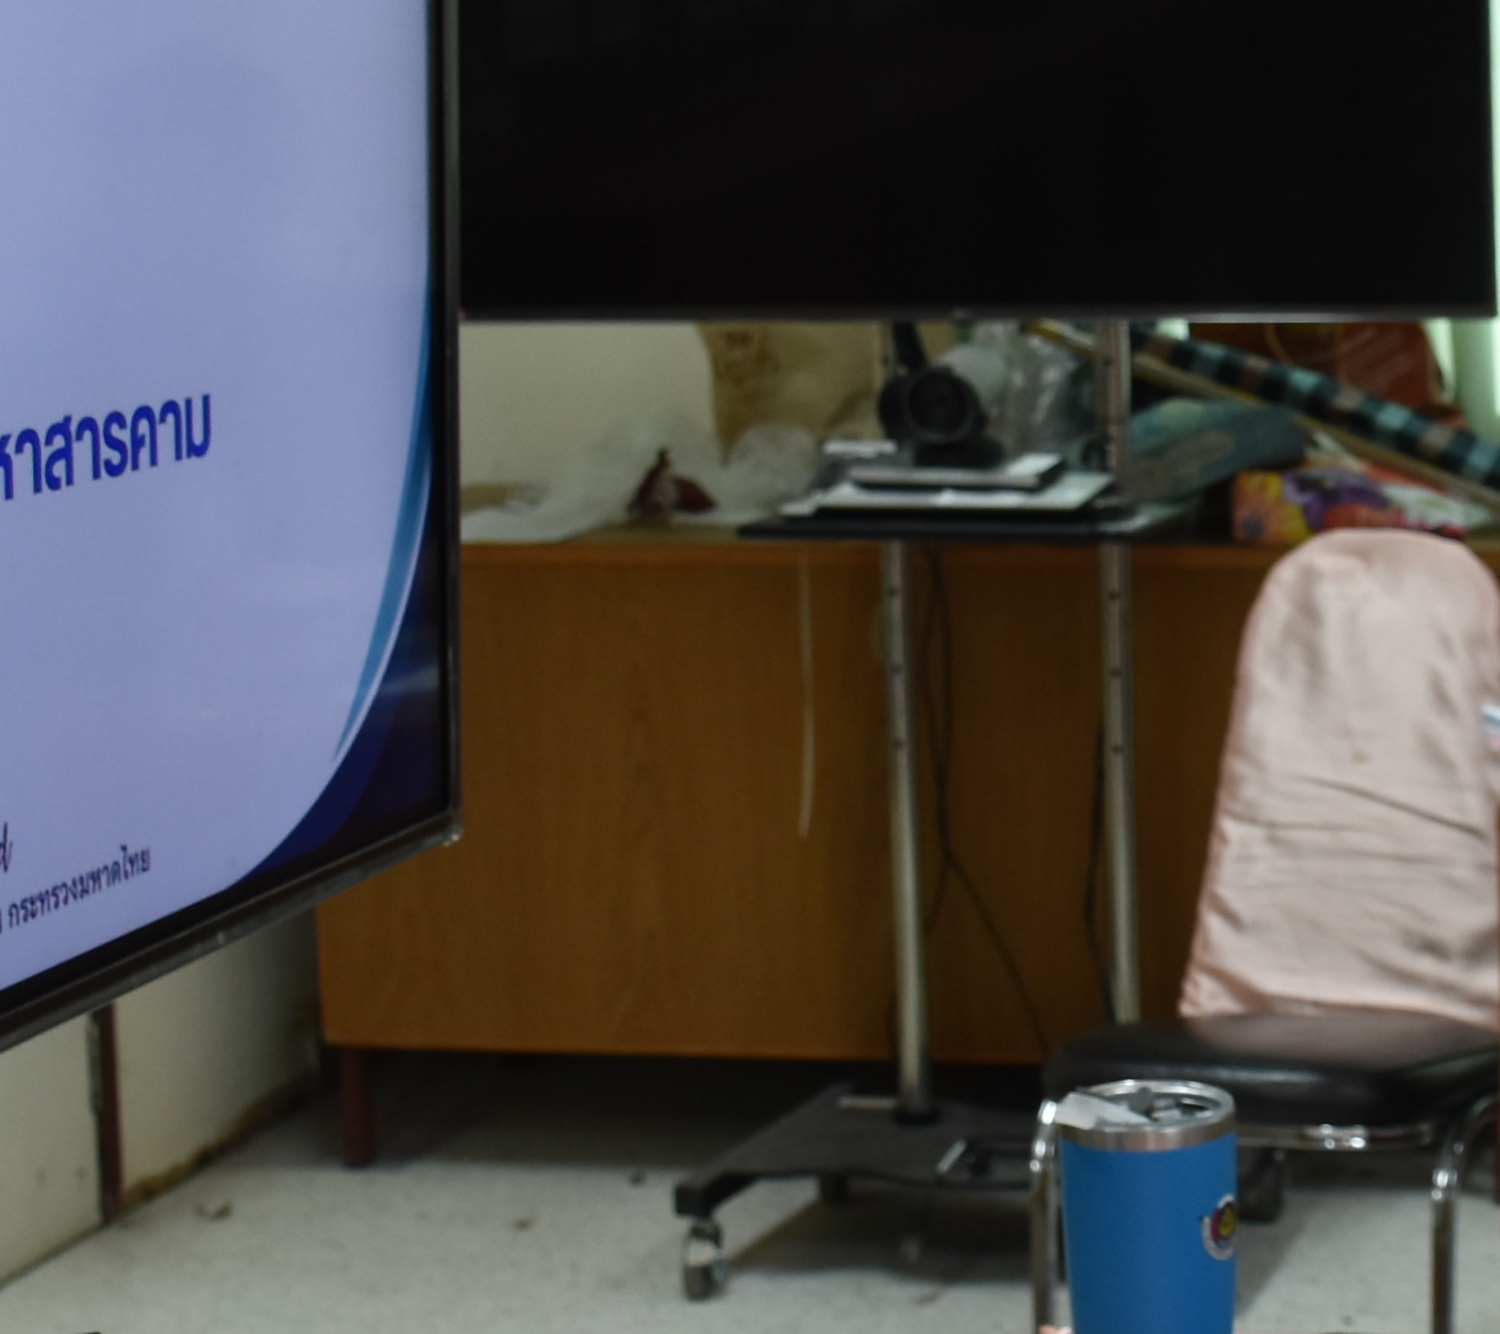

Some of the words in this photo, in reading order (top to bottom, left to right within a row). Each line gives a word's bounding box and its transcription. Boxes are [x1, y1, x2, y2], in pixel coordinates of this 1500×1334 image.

[7, 844, 151, 929] กระทรวงมหาดไทย
